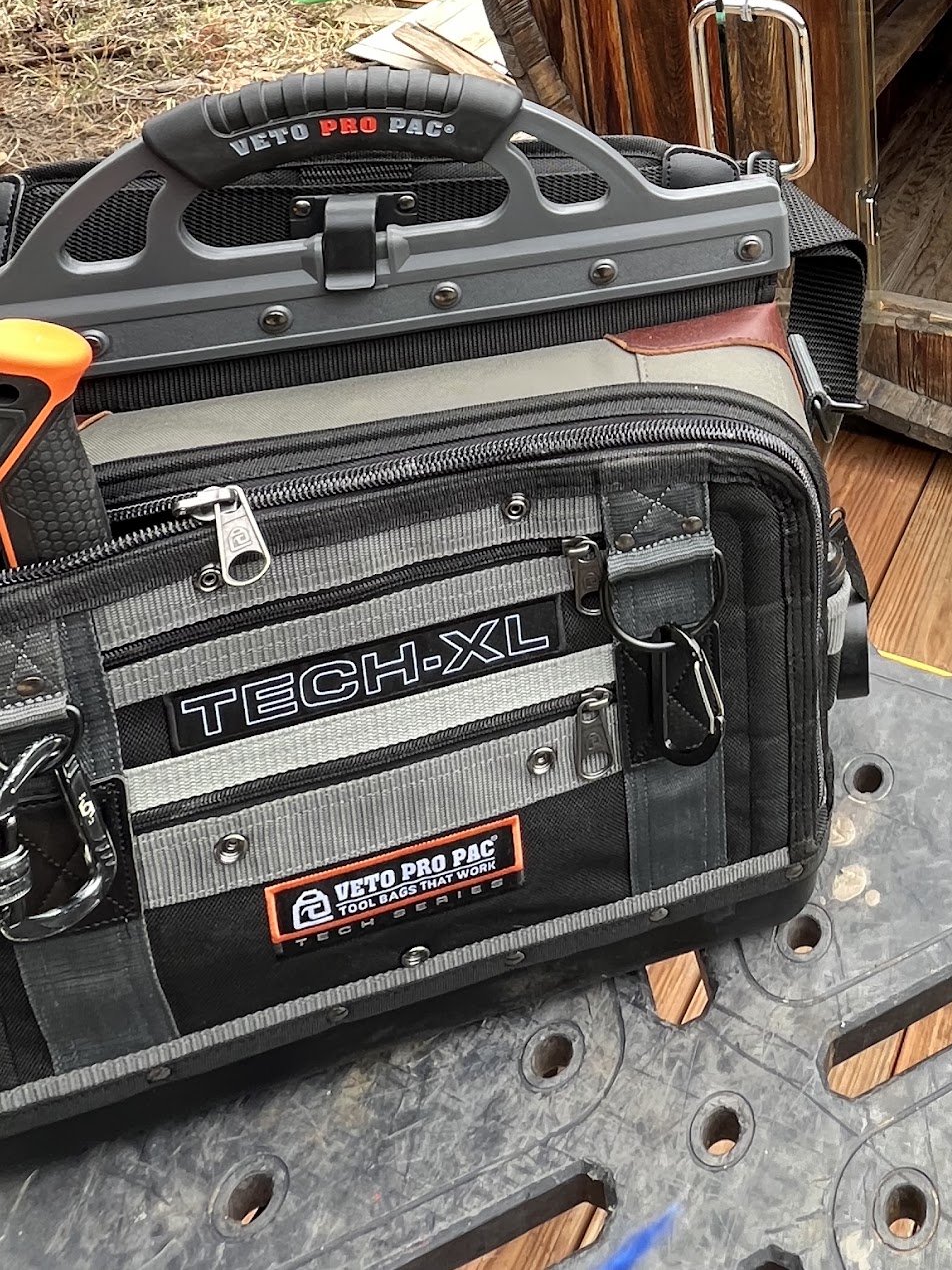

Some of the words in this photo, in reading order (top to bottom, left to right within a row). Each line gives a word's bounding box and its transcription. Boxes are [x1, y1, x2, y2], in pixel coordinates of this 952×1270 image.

[230, 123, 310, 157] VETO
[319, 115, 377, 137] PRO
[180, 614, 550, 737] TECH-XL
[333, 869, 396, 902] VETO
[401, 854, 447, 881] PRO
[338, 899, 375, 917] TOOL
[379, 884, 417, 904] BAGS
[419, 873, 453, 892] THAT
[455, 859, 497, 880] WORK
[295, 918, 375, 948] TECH
[393, 878, 504, 919] SERIES
